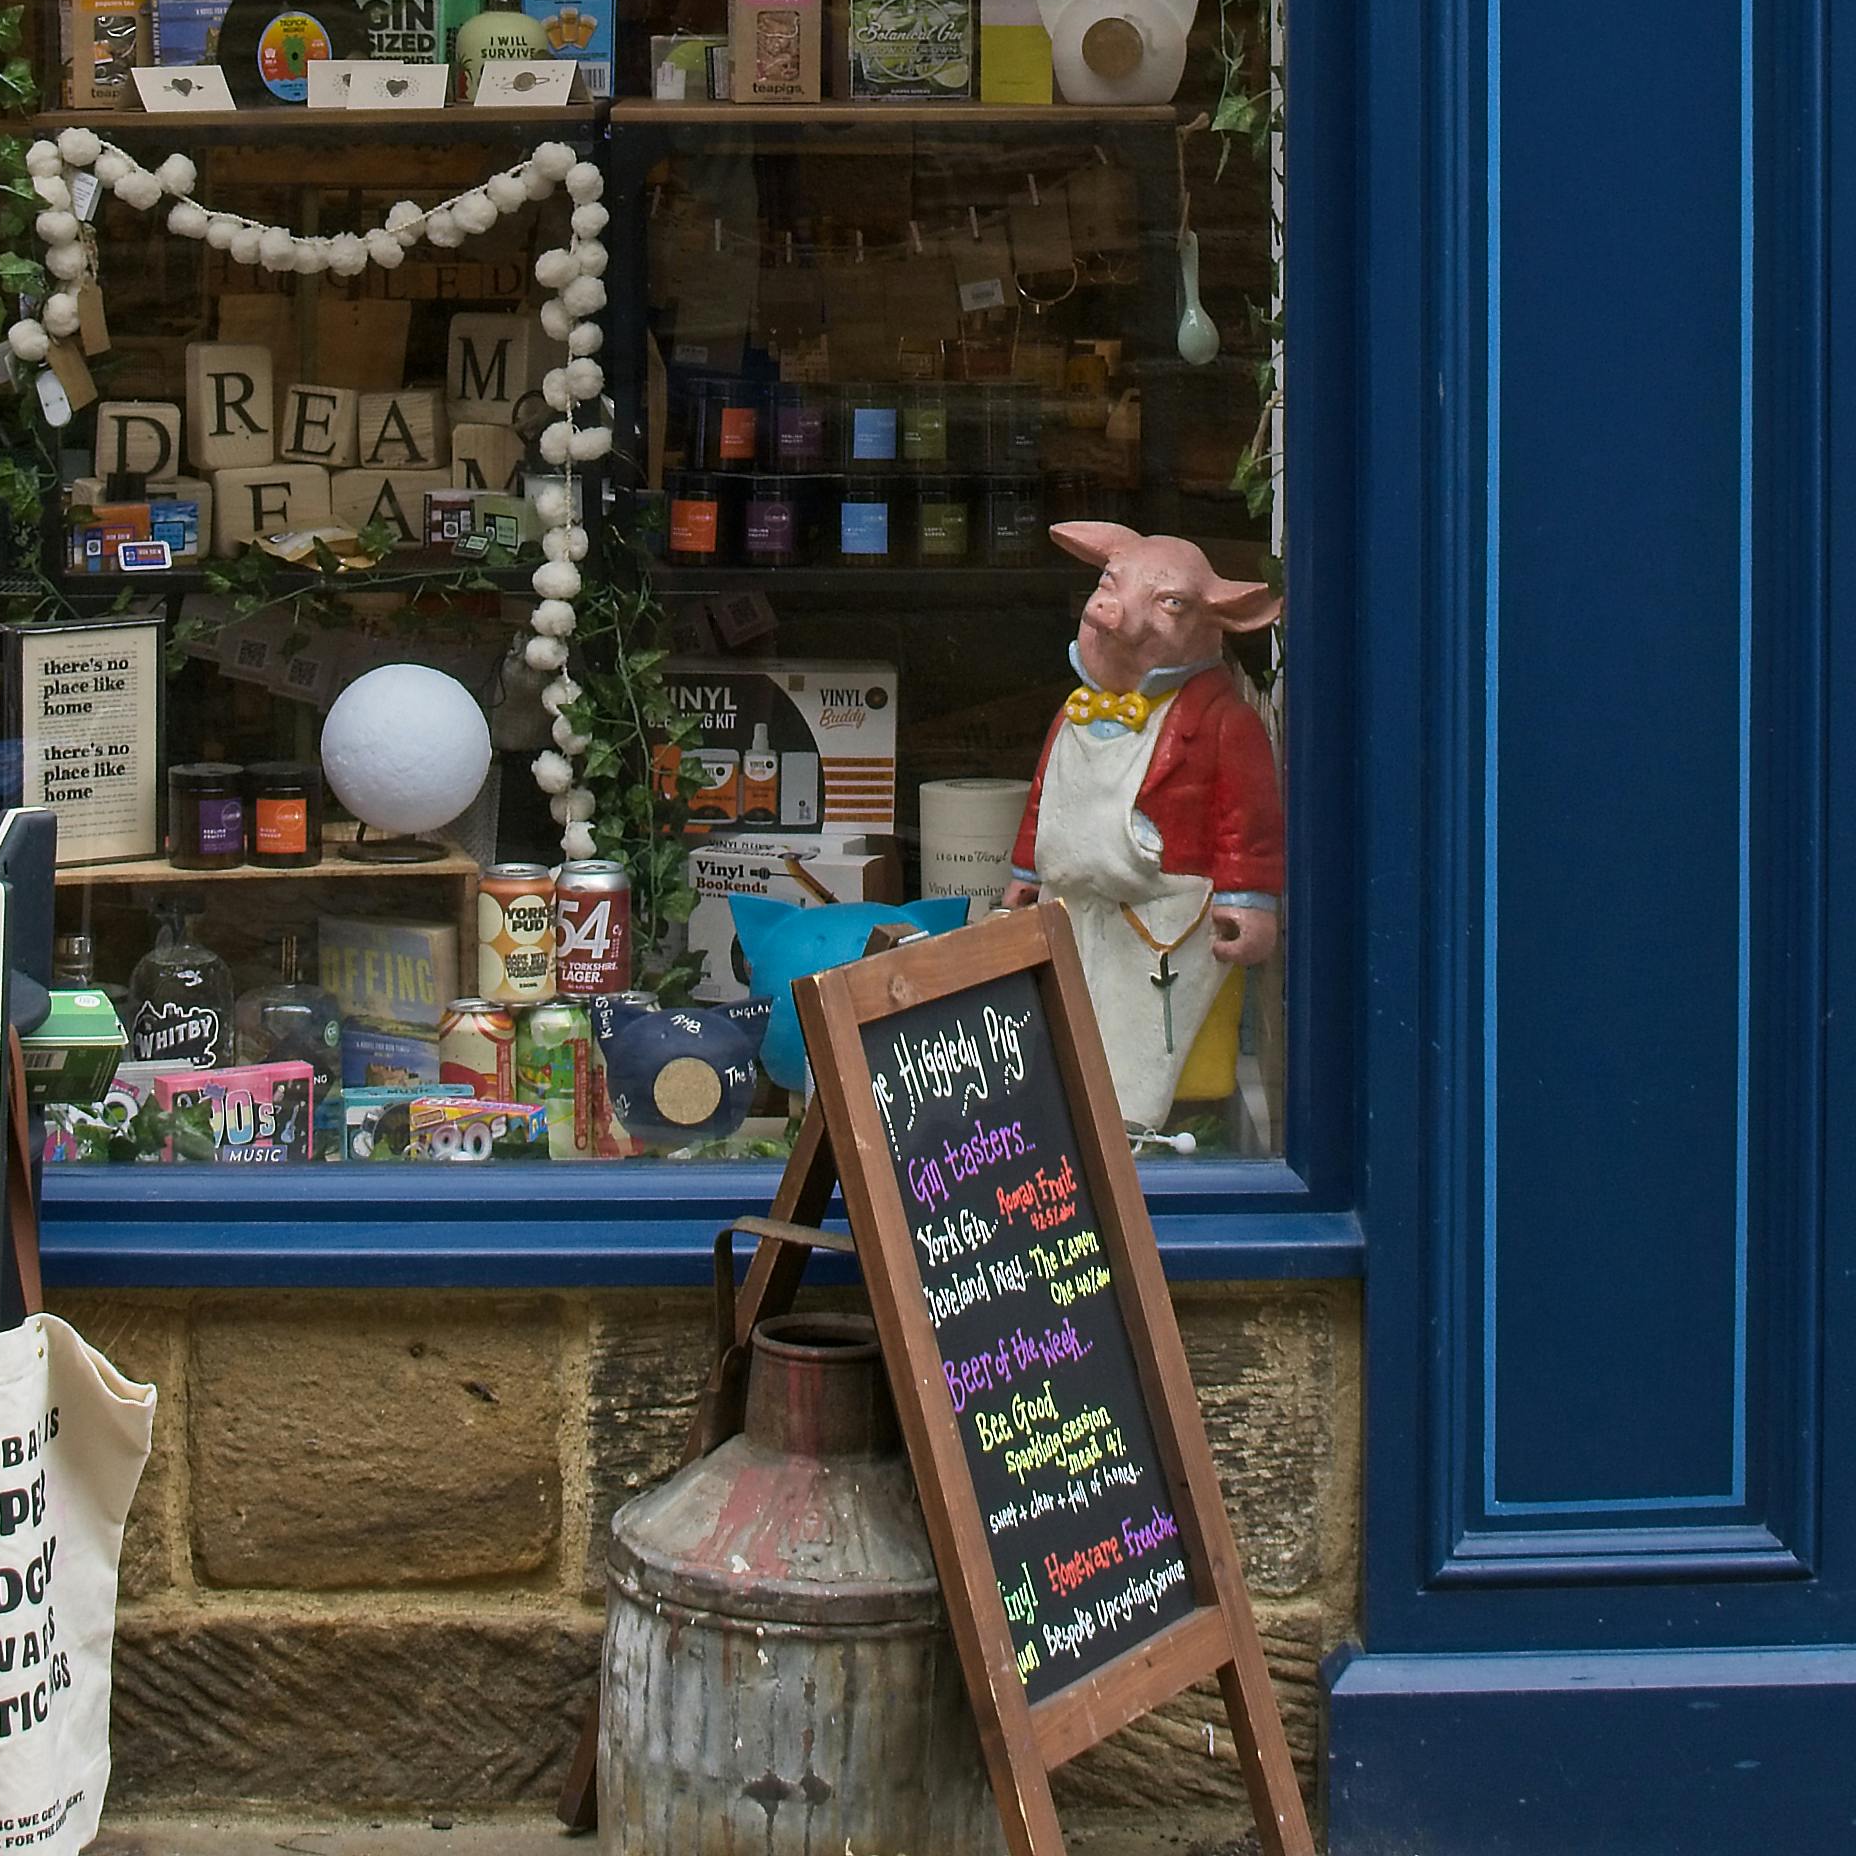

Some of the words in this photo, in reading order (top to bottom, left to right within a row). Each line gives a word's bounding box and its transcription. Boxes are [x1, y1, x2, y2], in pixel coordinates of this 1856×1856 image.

[361, 0, 434, 31] GIN
[497, 36, 528, 47] WILL
[856, 21, 937, 43] Botanical
[937, 21, 963, 42] Gin
[367, 33, 435, 54] SIZED
[480, 47, 537, 60] SURVIVE
[44, 657, 102, 676] there's
[107, 658, 129, 670] no
[44, 680, 89, 699] place
[93, 677, 125, 692] like
[820, 689, 863, 707] VINYL
[44, 700, 93, 716] home
[819, 709, 866, 729] Buddy
[716, 713, 737, 729] KIT
[44, 743, 104, 762] there's
[108, 743, 130, 756] no
[44, 765, 89, 785] place
[94, 762, 126, 777] like
[44, 786, 94, 802] home
[936, 853, 975, 863] LEGEND
[975, 851, 1009, 863] Vinyl
[696, 860, 744, 880] Vinyl
[696, 877, 768, 894] Bookends
[928, 882, 951, 894] Vinyl
[953, 883, 1006, 896] cleaning
[512, 920, 544, 932] PUD
[557, 899, 611, 959] 54
[135, 1015, 213, 1059] WHITBY
[894, 1019, 988, 1107] Higgledy
[725, 1066, 746, 1088] The
[229, 1149, 282, 1163] MUSIC
[908, 1156, 950, 1213] Gin
[917, 1216, 965, 1268] York
[996, 1180, 1043, 1225] Roman
[1035, 1154, 1078, 1201] Fruit
[1029, 1243, 1059, 1280] The
[1057, 1230, 1100, 1267] Lemon
[1050, 1279, 1076, 1306] One
[943, 1350, 994, 1413] Beer
[995, 1338, 1012, 1383] of
[1010, 1328, 1039, 1372] the
[43, 1407, 61, 1444] IS
[974, 1412, 1012, 1452] Bee
[1011, 1380, 1060, 1437] Good
[1062, 1404, 1112, 1446] session
[1067, 1434, 1103, 1476] mead
[988, 1500, 1019, 1535] sweet
[1029, 1488, 1055, 1519] clear
[1066, 1478, 1089, 1514] full
[1089, 1467, 1103, 1497] of
[1044, 1535, 1124, 1598] Homeware
[1120, 1504, 1178, 1558] Frenchic
[1042, 1607, 1097, 1659] Bespoke
[1095, 1576, 1158, 1633] Upcycling
[1148, 1556, 1186, 1597] Service
[17, 1813, 39, 1828] WE
[5, 1833, 34, 1848] FOR
[36, 1823, 56, 1841] THE
